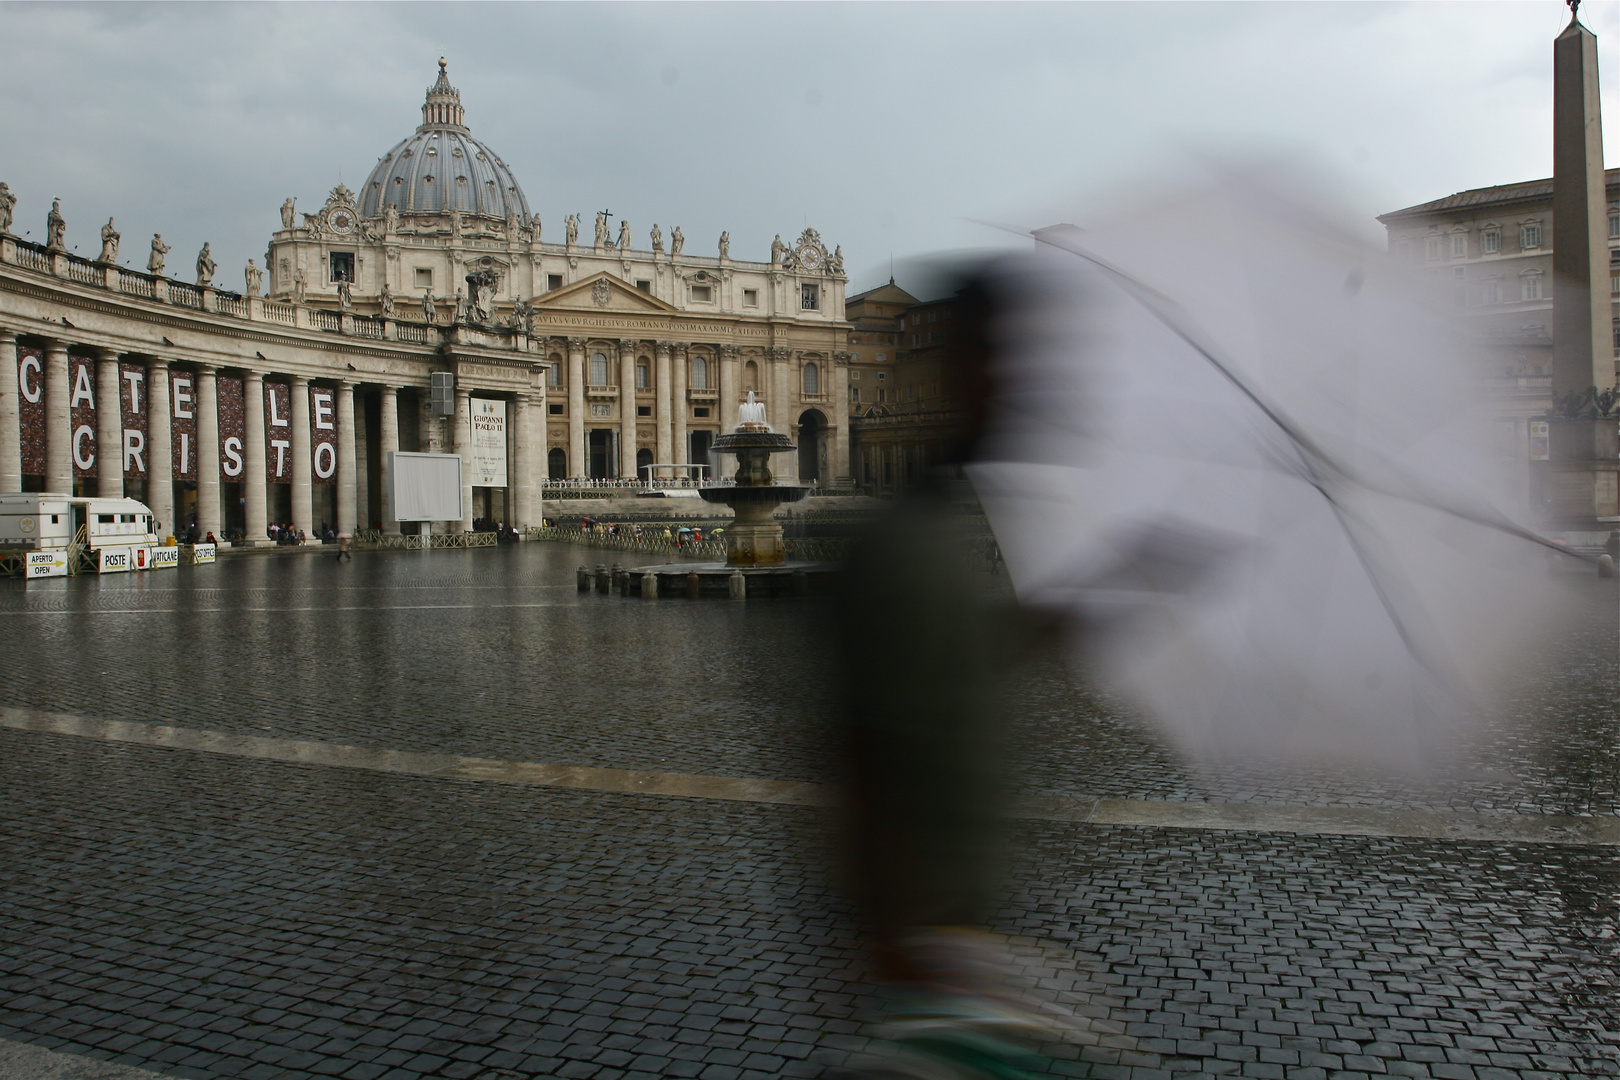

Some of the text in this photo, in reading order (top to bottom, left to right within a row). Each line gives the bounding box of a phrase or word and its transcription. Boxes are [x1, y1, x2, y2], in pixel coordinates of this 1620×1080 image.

[474, 415, 503, 424] GIOVANNI
[475, 423, 496, 431] PAOLO
[31, 554, 53, 564] APERTO
[105, 554, 126, 566] POSTE
[152, 550, 177, 563] VATICANE
[34, 566, 50, 575] OPEN
